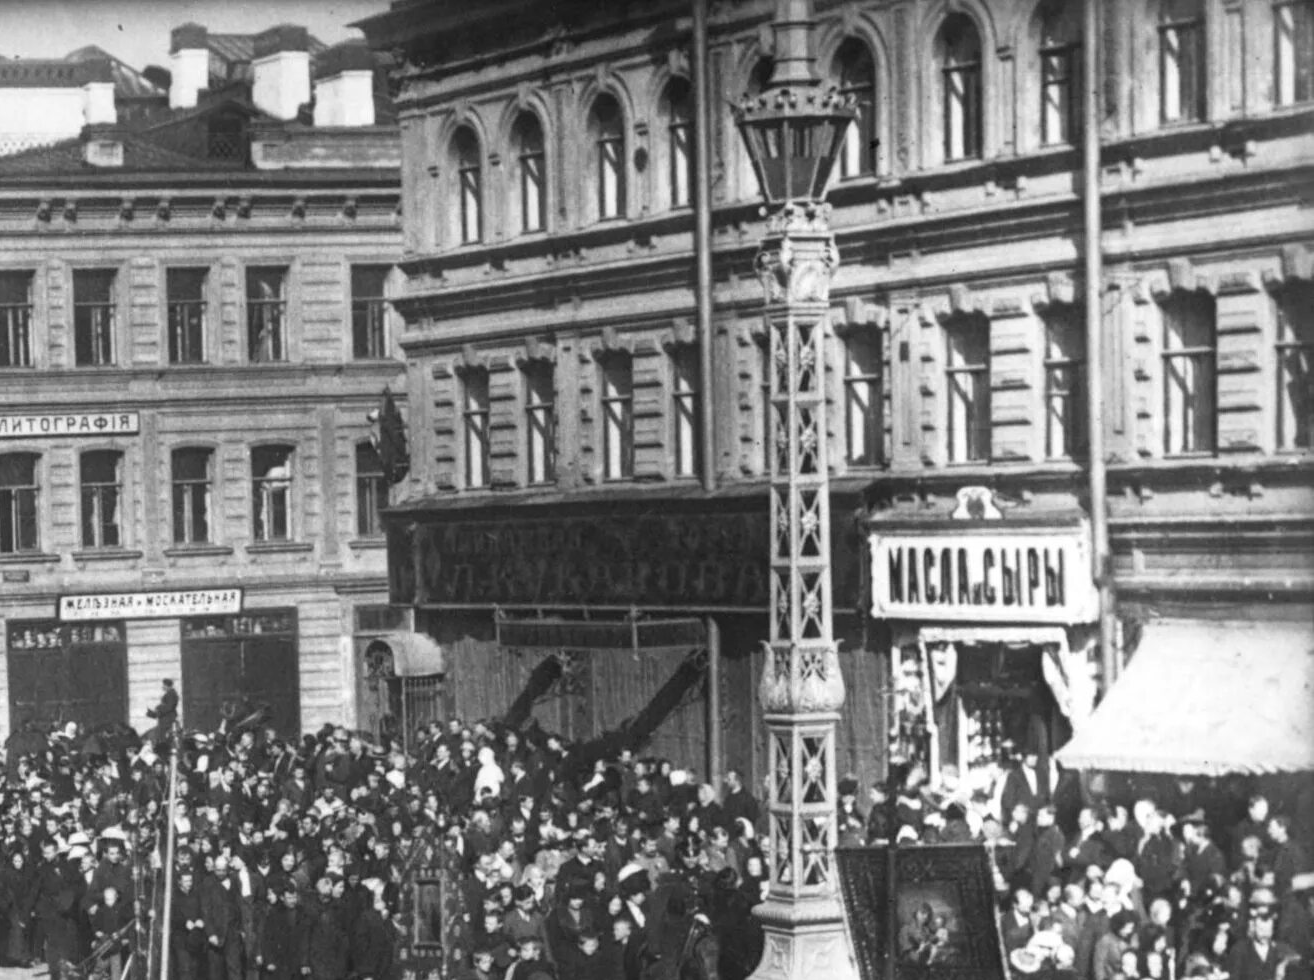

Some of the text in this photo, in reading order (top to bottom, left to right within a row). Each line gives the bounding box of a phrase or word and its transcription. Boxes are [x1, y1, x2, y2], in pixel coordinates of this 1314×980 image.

[889, 546, 970, 605] МАСЛА
[983, 547, 1066, 606] СЫРЫ
[147, 592, 236, 607] МОСКАТЕЛЬНАЯ
